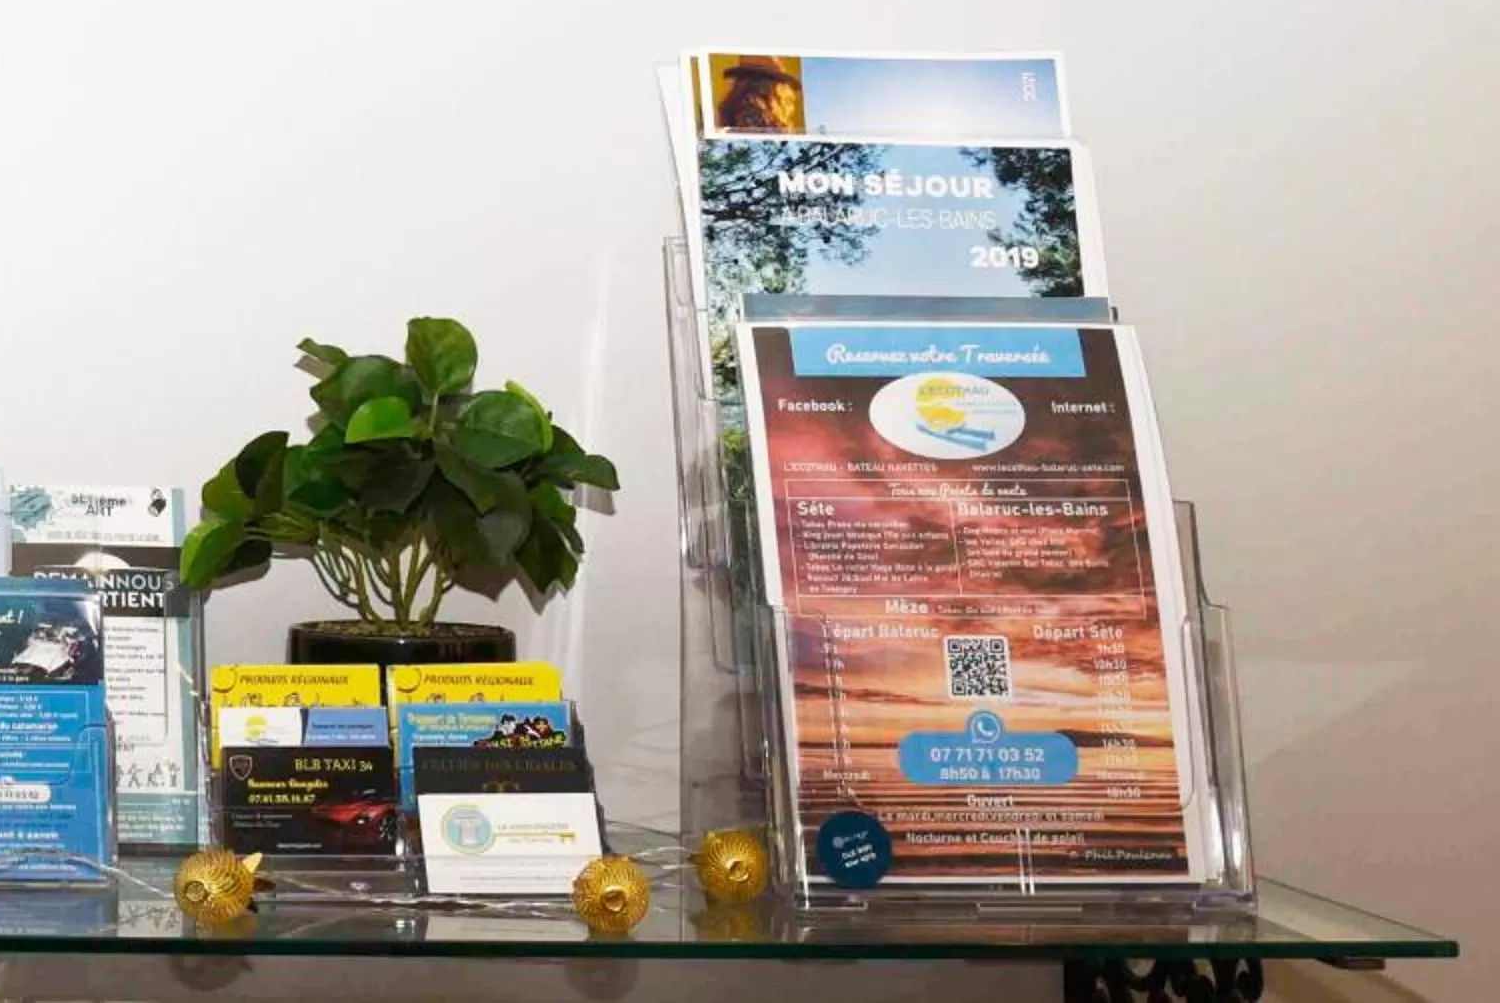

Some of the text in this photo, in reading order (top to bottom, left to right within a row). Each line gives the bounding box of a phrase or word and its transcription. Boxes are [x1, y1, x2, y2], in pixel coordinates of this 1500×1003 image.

[779, 168, 994, 198] MON SÉJOUR
[970, 246, 1040, 269] 2019
[777, 399, 845, 413] Facebook
[1050, 399, 1108, 414] Internet
[929, 748, 1045, 762] 07 71 71 03 52
[324, 758, 357, 772] TAXI
[998, 767, 1042, 780] 17h30
